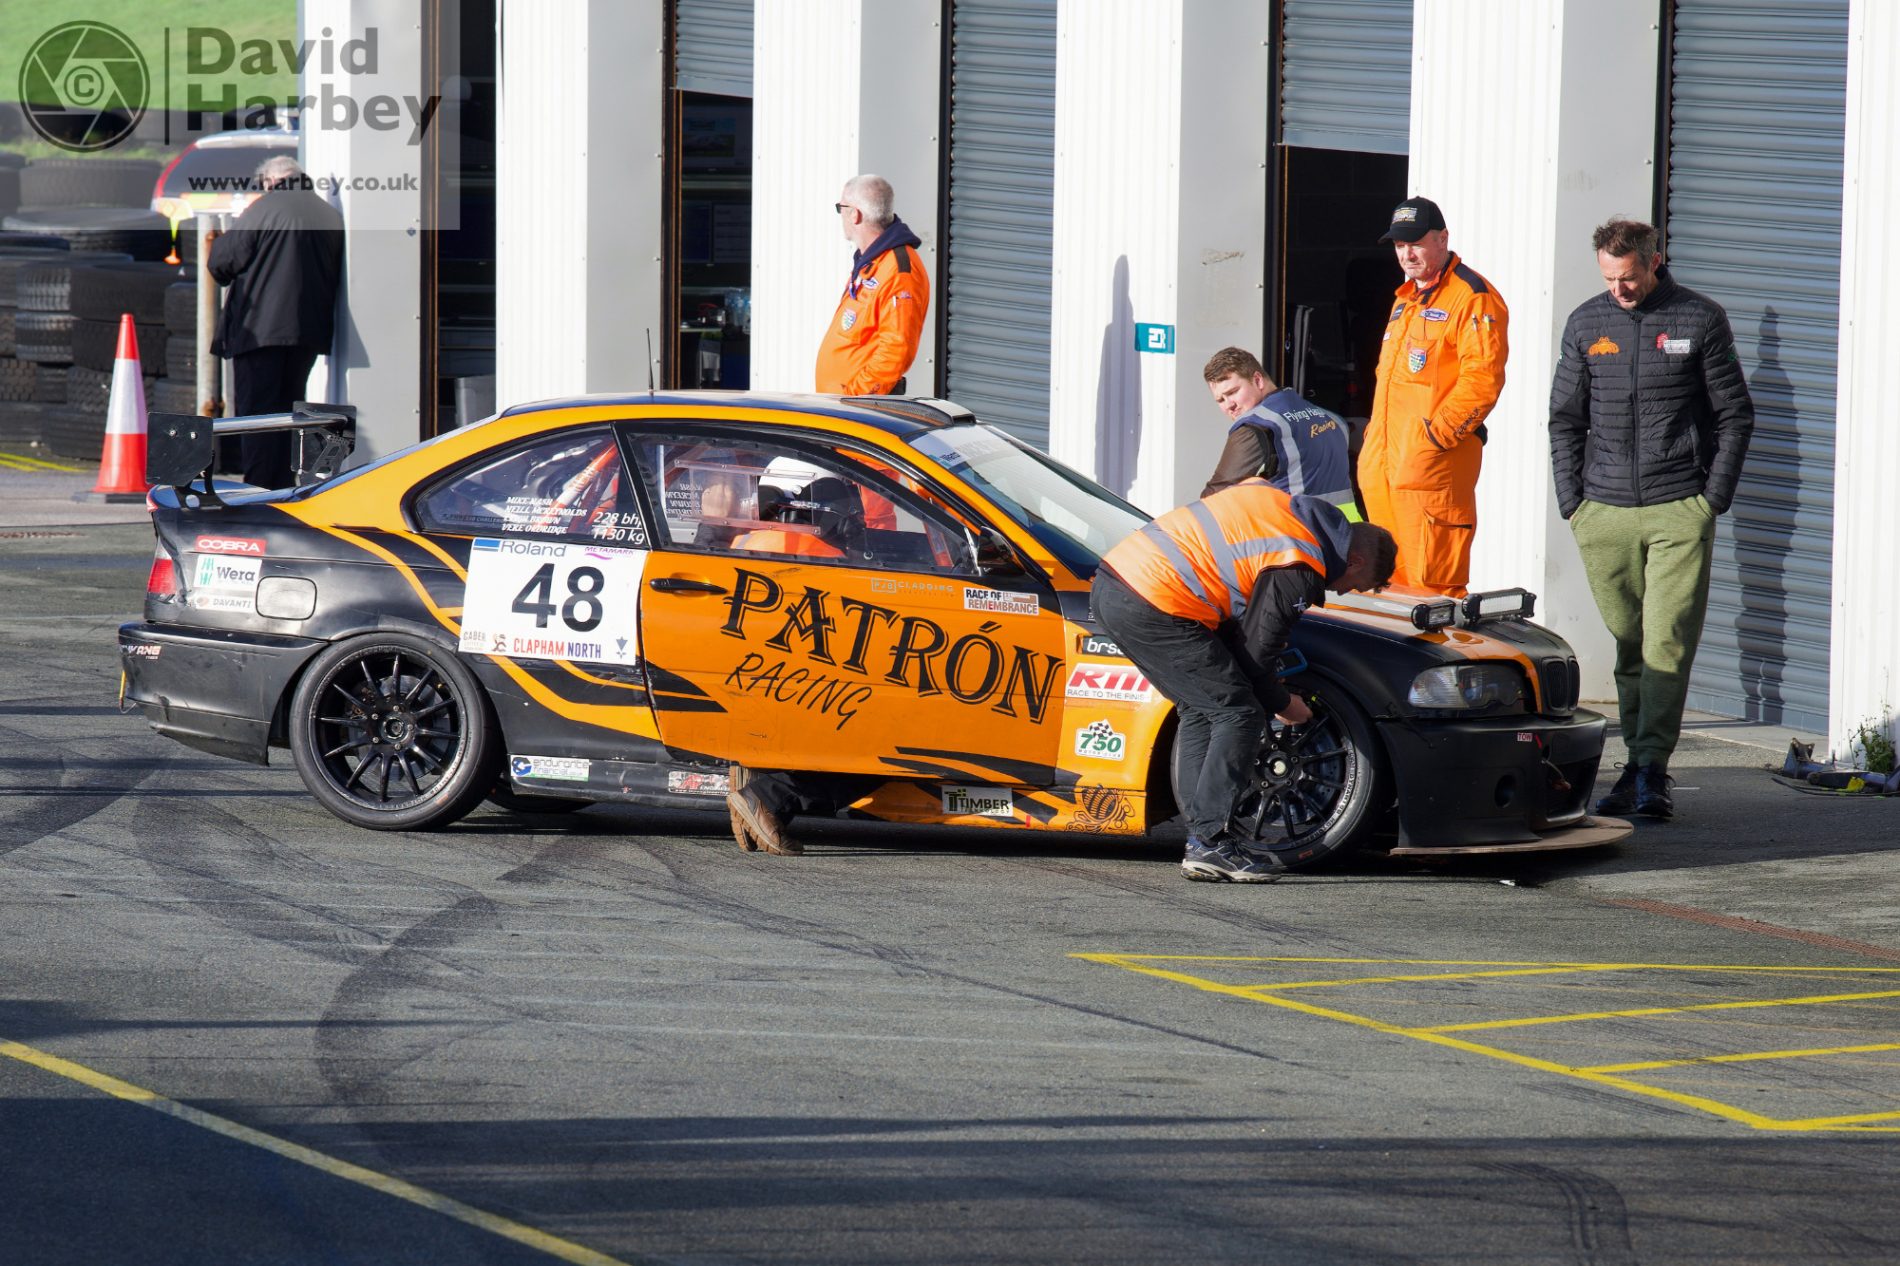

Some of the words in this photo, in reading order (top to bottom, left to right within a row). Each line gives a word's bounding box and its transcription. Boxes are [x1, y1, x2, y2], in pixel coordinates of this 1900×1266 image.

[1283, 408, 1310, 422] Flying
[1310, 420, 1336, 438] Racing
[594, 511, 620, 524] 228
[593, 527, 626, 540] 1130
[628, 529, 645, 544] kg
[198, 538, 261, 552] COBRA
[501, 540, 568, 558] Roland
[216, 566, 256, 582] Wera
[512, 563, 605, 633] 48
[965, 588, 989, 599] RACE
[212, 598, 252, 609] DAVANTI
[968, 599, 1038, 615] REMEMBRANCE
[513, 638, 564, 657] CLAPHAM
[568, 641, 601, 659] NORTH
[720, 567, 1067, 725] PATRÓN
[725, 652, 872, 731] RACING
[1067, 688, 1090, 697] RACE
[1093, 689, 1104, 698] TO
[1106, 691, 1122, 699] THE
[1080, 733, 1122, 753] 750
[958, 797, 1010, 810] TIMBER
